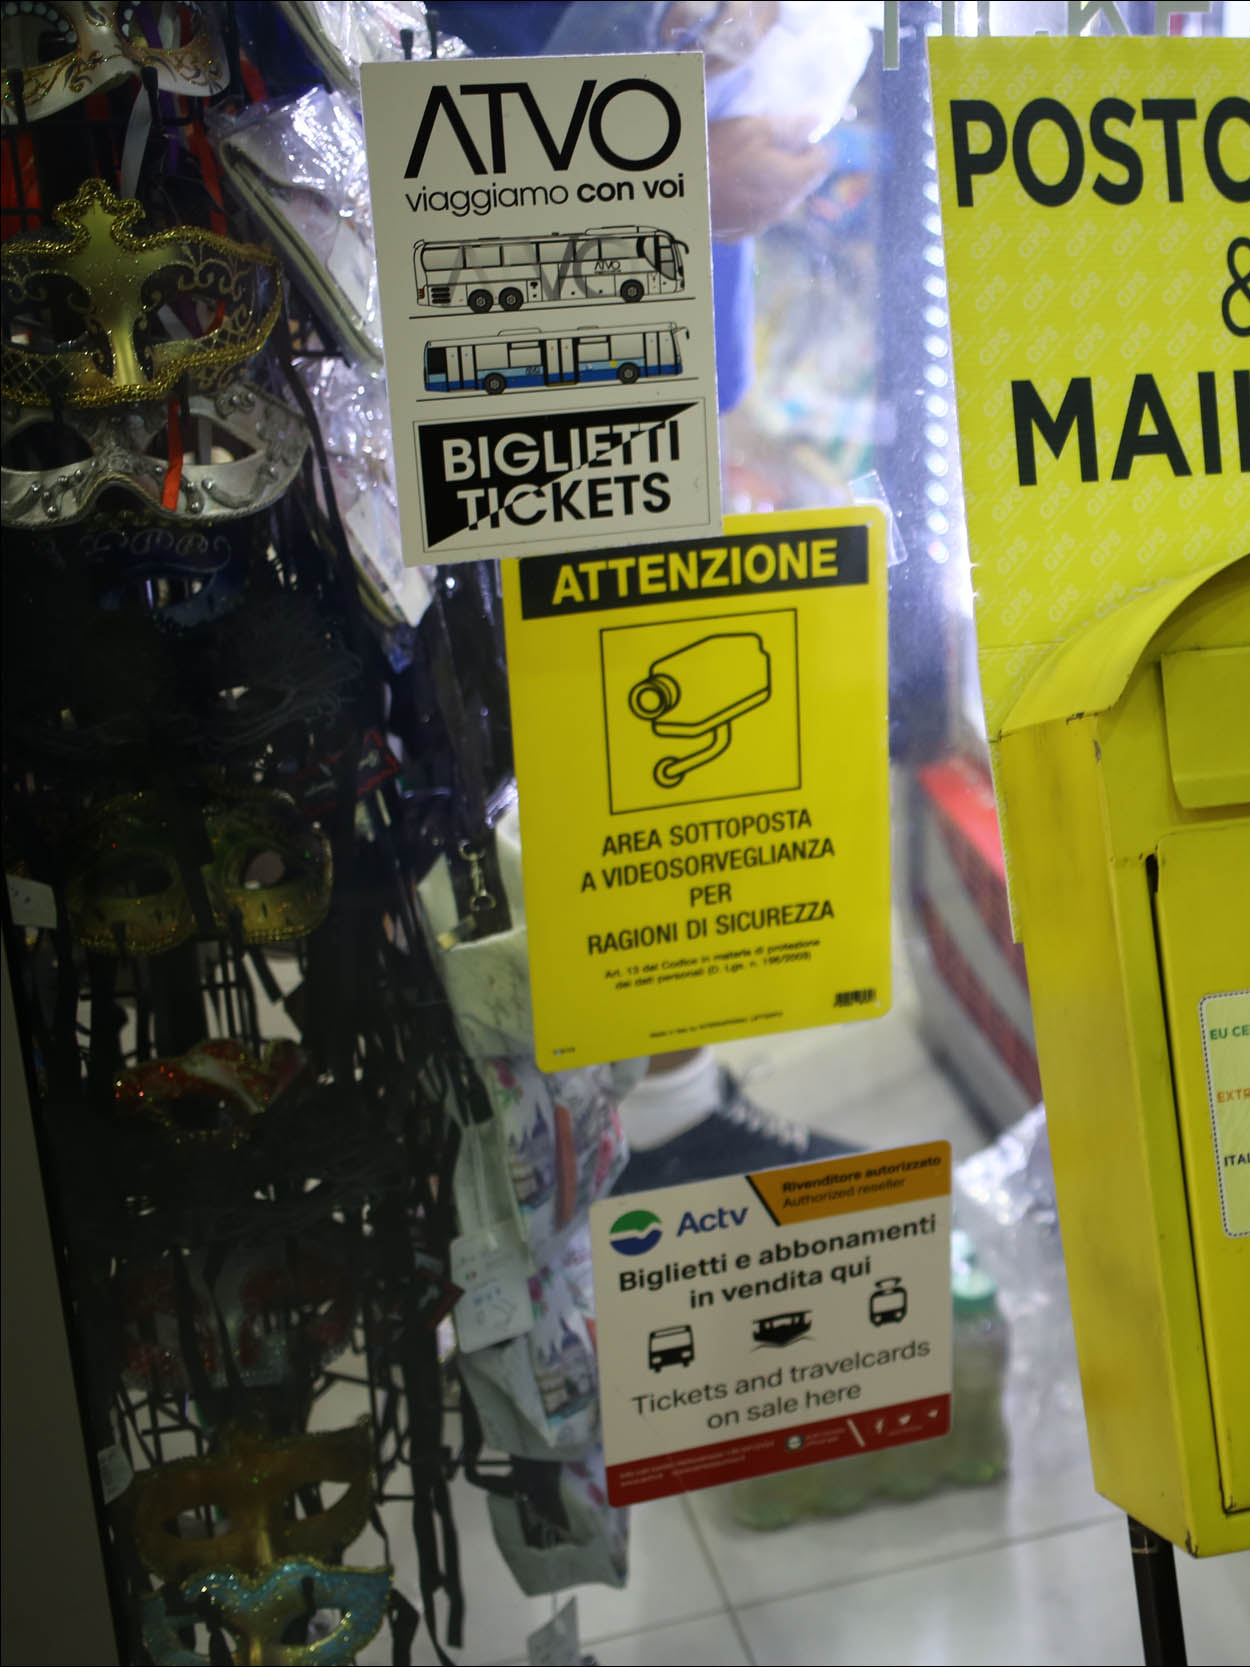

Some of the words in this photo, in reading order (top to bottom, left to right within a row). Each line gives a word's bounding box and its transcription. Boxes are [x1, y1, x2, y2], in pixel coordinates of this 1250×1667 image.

[404, 78, 681, 179] ATVO
[405, 182, 568, 217] viaggiamo
[577, 181, 634, 203] con
[643, 173, 685, 199] voi
[442, 420, 680, 482] BIGLIETTI
[457, 472, 671, 531] TICKETS
[552, 538, 838, 606] ATTENZIONE
[602, 829, 662, 857] AREA
[669, 808, 812, 847] SOTTOPOSTA
[580, 872, 597, 892] A
[602, 838, 835, 889] VIDEOSORVEGLIANZA
[690, 882, 732, 907] PER
[587, 922, 678, 956] RAGIONI
[686, 918, 707, 941] DI
[715, 900, 835, 935] SICUREZZA
[1210, 1028, 1228, 1040] EU
[782, 1171, 862, 1193] Rivenditore
[865, 1156, 942, 1179] autorizzato
[676, 1206, 749, 1238] Actv
[619, 1253, 727, 1293] Biglietti
[734, 1251, 751, 1270] e
[759, 1213, 936, 1267] abbonamenti
[689, 1290, 714, 1309] in
[721, 1266, 822, 1302] vendita
[830, 1256, 872, 1284] qui
[632, 1380, 728, 1415] Tickets
[735, 1367, 783, 1395] and
[789, 1338, 931, 1385] travelcards
[707, 1410, 740, 1430] on
[747, 1395, 799, 1422] sale
[805, 1382, 861, 1410] here
